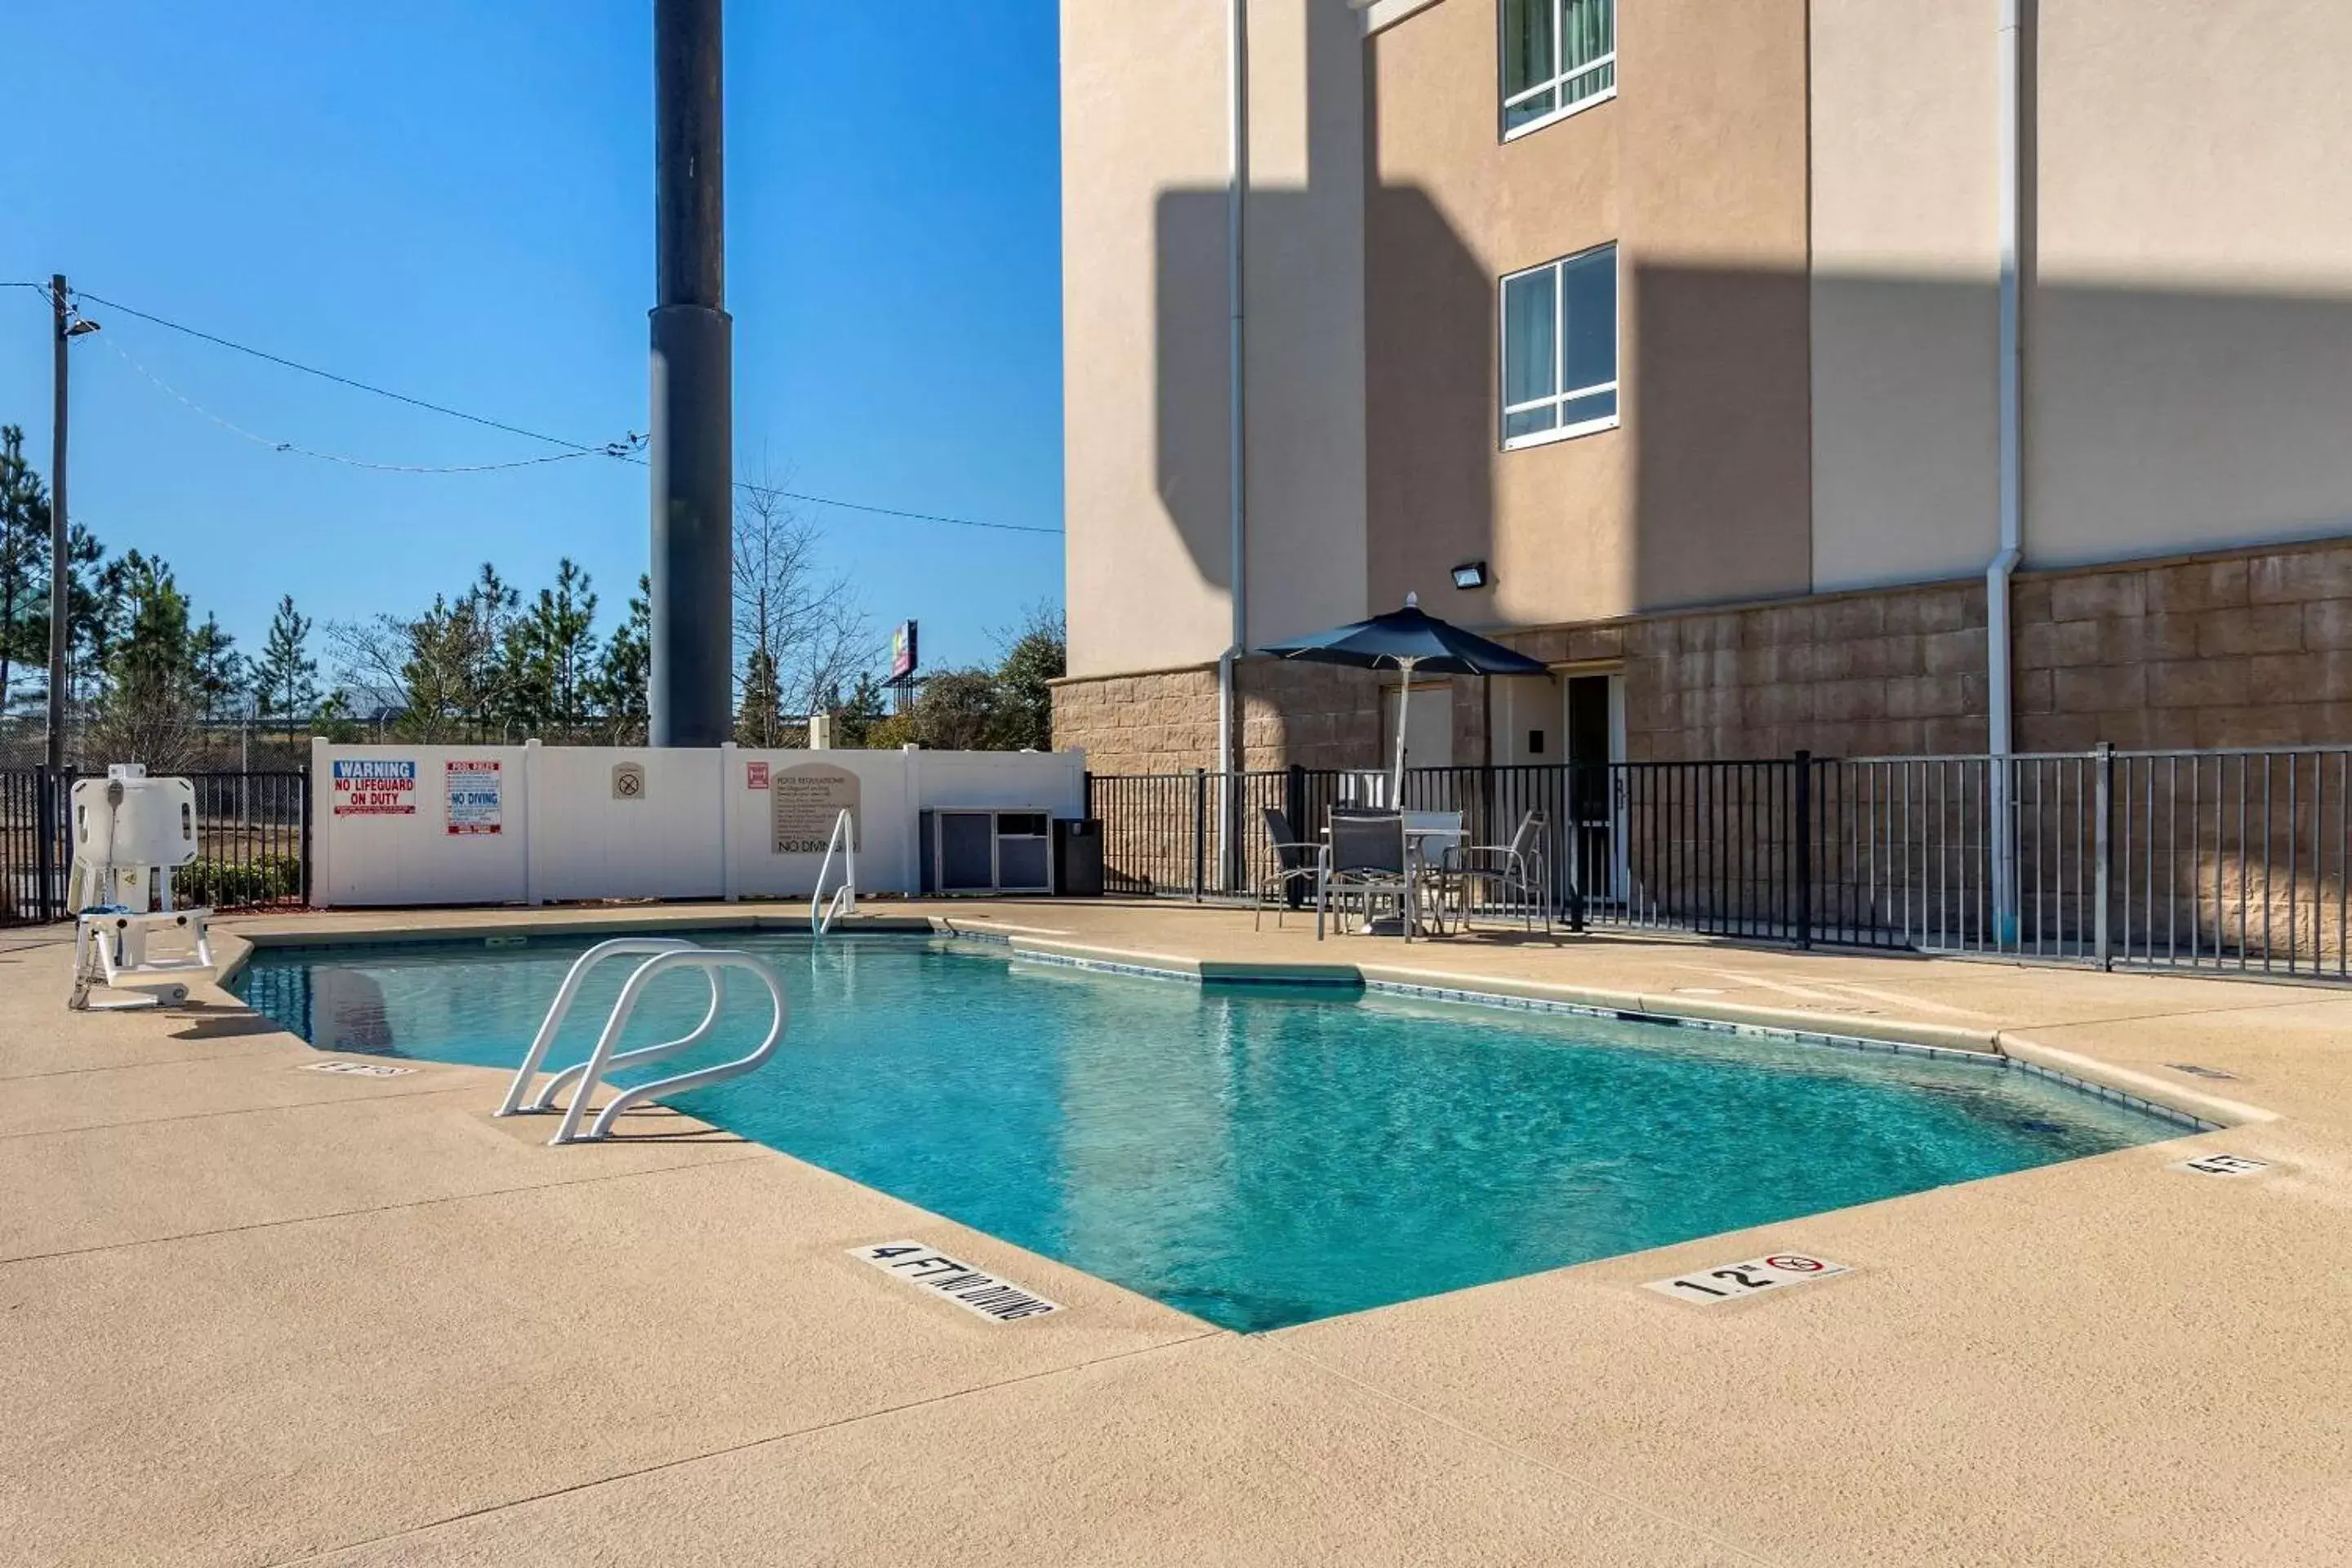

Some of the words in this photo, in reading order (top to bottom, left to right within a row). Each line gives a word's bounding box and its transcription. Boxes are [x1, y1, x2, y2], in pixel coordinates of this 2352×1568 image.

[339, 762, 410, 777] WARNING
[335, 779, 350, 791] NO
[355, 779, 413, 791] LIFEGUARD
[351, 793, 365, 804] ON
[371, 793, 399, 804] DUTY
[452, 793, 465, 804] NO
[468, 792, 497, 804] DIVING
[778, 840, 798, 853] NO
[871, 1247, 923, 1258] 4
[891, 1257, 969, 1277] FT
